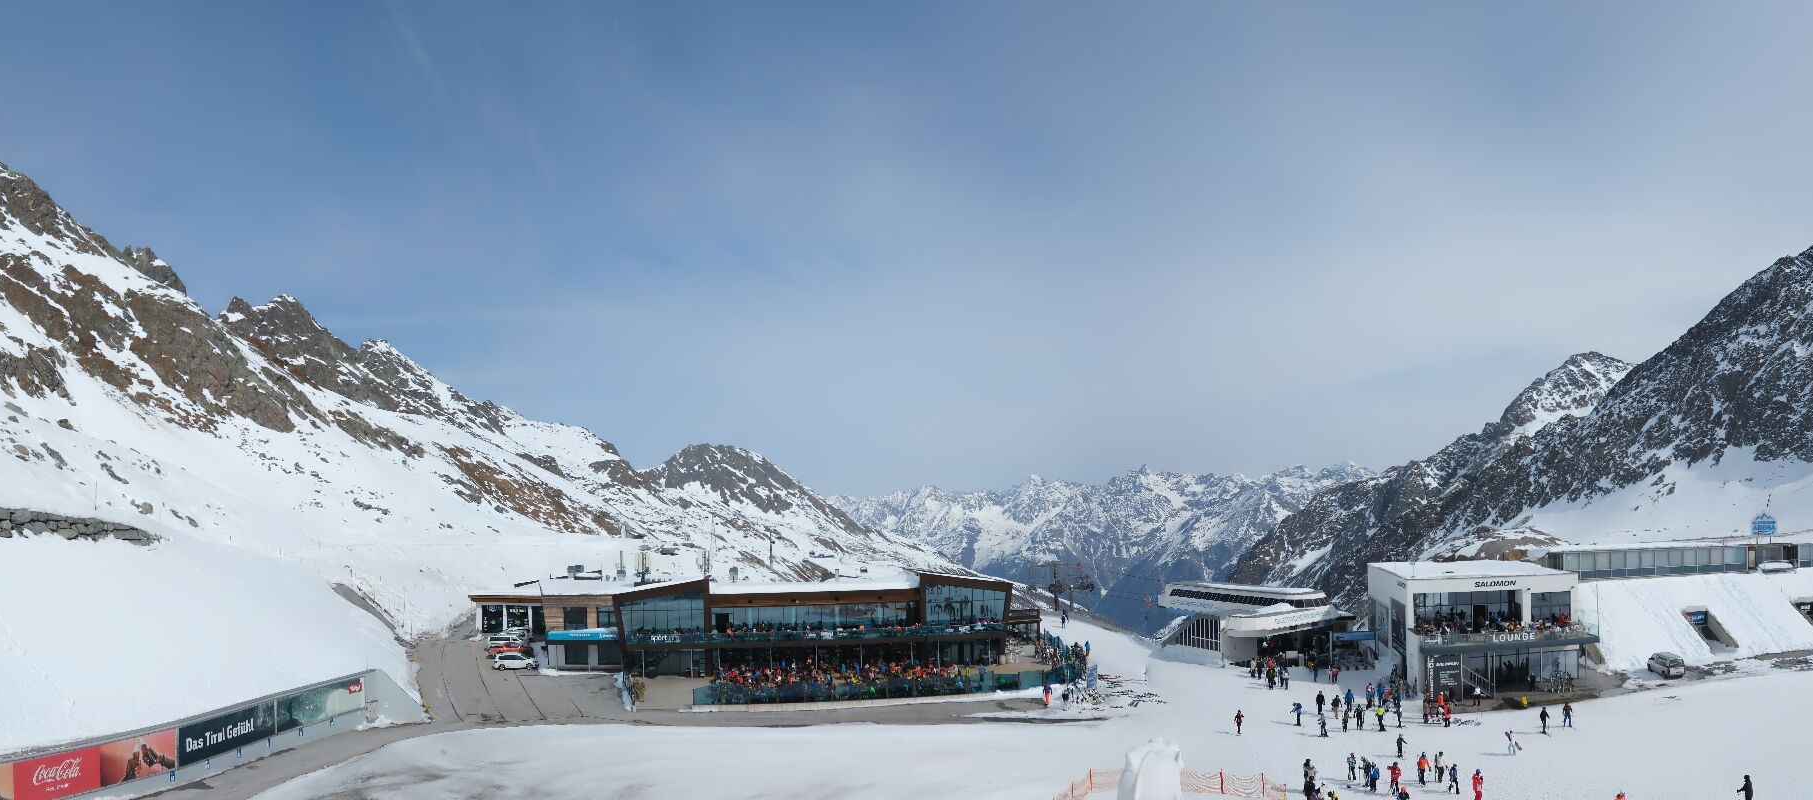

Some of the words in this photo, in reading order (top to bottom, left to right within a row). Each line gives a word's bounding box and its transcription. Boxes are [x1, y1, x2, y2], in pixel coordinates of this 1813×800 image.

[1475, 580, 1517, 588] SALOMON
[1493, 632, 1536, 642] LOUNGE
[186, 737, 204, 753] Das
[204, 730, 226, 747] Tirol
[226, 718, 254, 739] Gefühl
